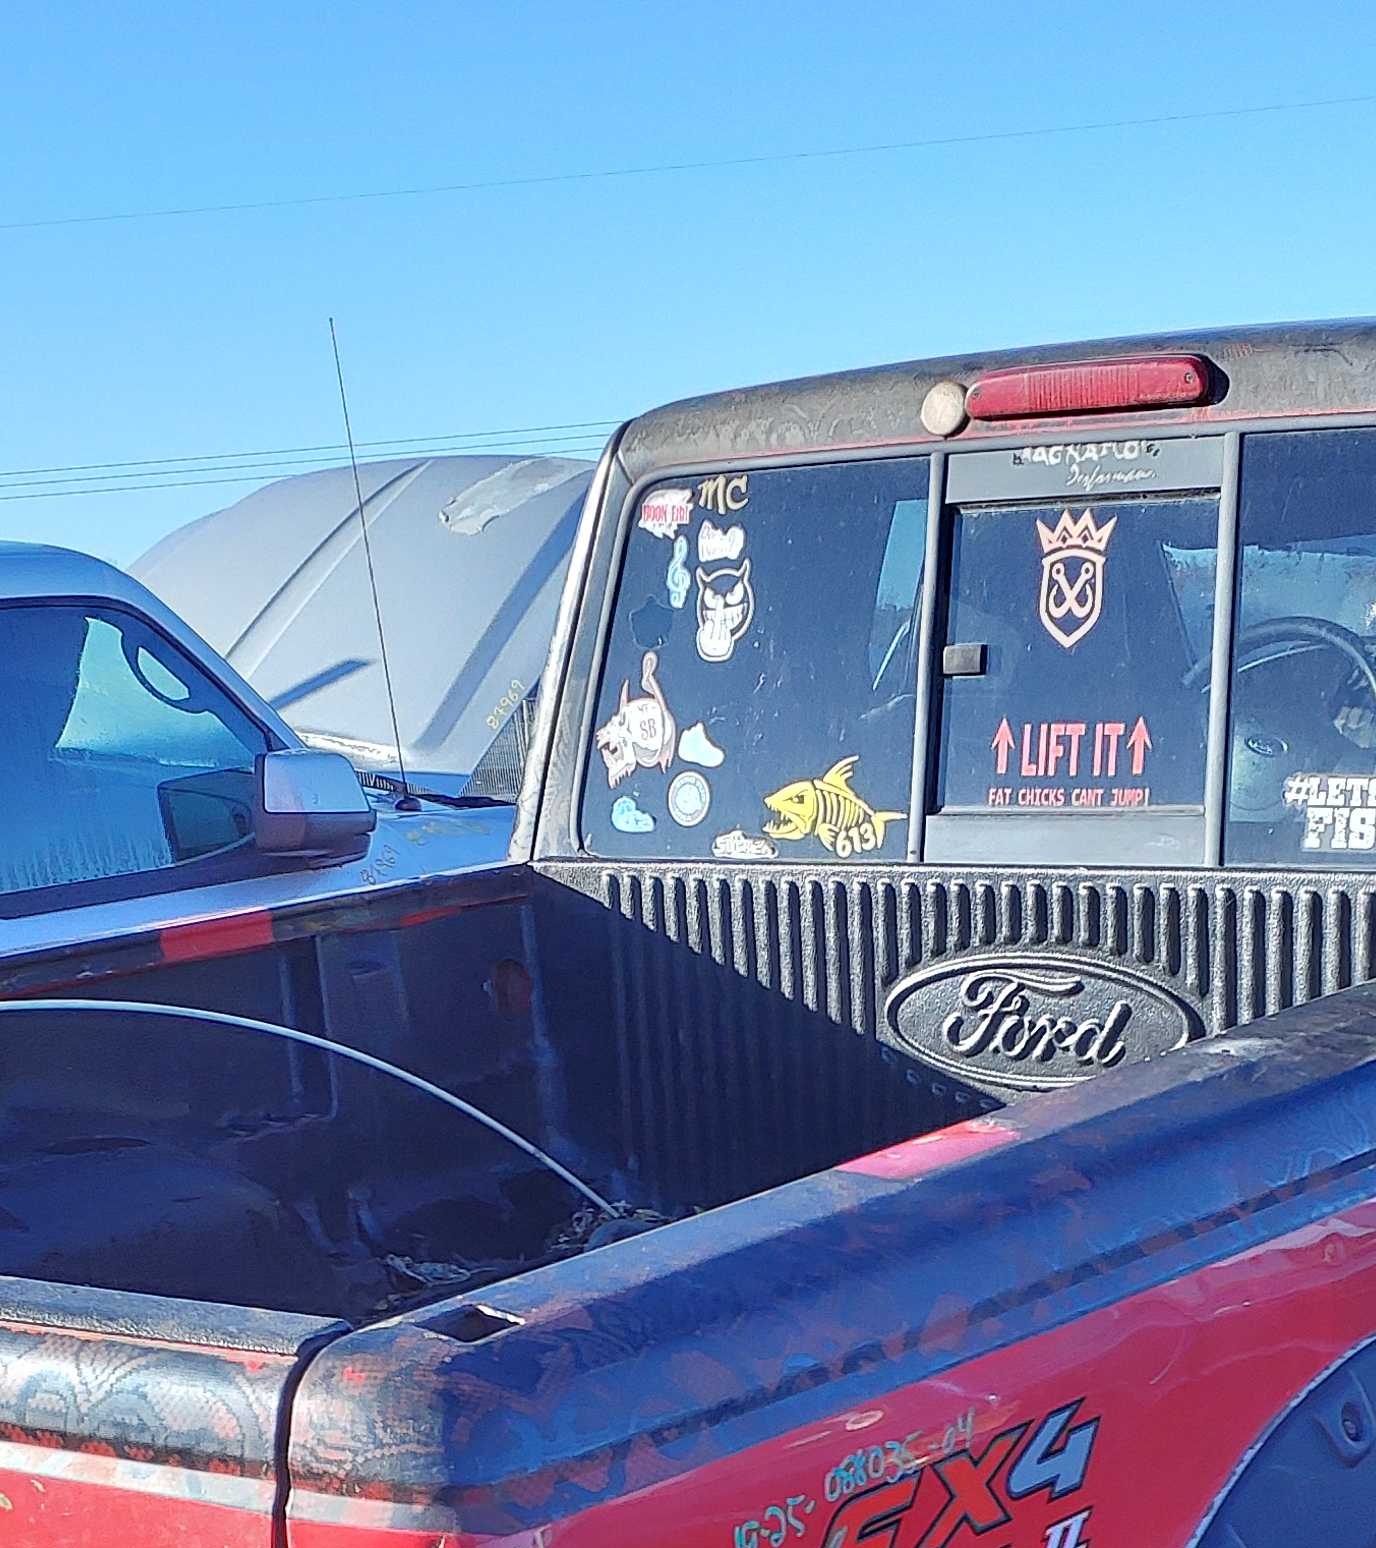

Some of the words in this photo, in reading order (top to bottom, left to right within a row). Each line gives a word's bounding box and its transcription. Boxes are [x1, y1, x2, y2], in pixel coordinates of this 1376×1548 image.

[696, 474, 750, 515] MC
[1021, 723, 1086, 777] LIFT
[1093, 722, 1126, 777] IT
[988, 788, 1012, 806] FAT
[1018, 788, 1065, 806] CHICKS
[1071, 788, 1104, 806] CANT
[1110, 788, 1150, 806] JUMP!
[835, 822, 876, 859] 613
[943, 969, 1132, 1068] Ford
